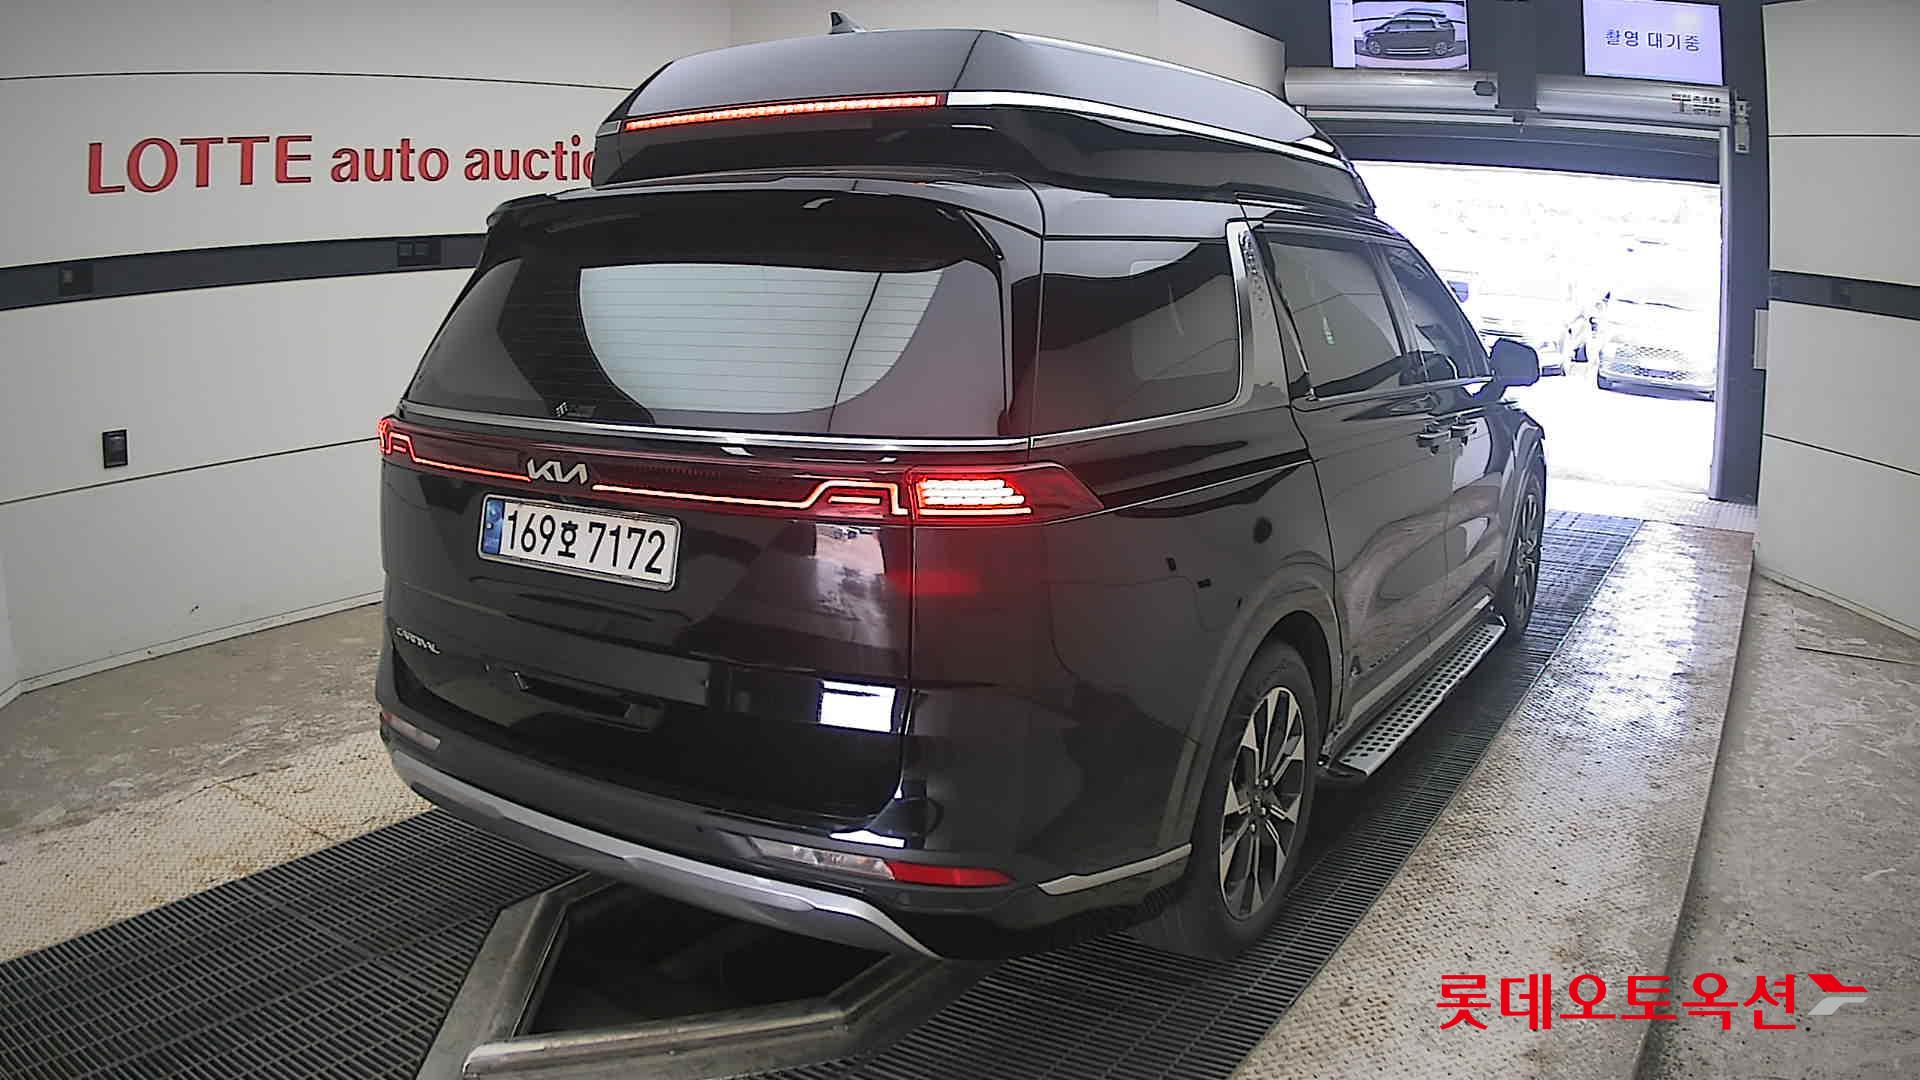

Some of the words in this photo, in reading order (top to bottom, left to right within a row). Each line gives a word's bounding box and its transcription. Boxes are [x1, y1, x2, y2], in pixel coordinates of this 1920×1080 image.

[1647, 32, 1700, 52] 대기중
[88, 134, 313, 195] LOTTE
[330, 138, 451, 183] auto
[588, 522, 667, 575] 7172
